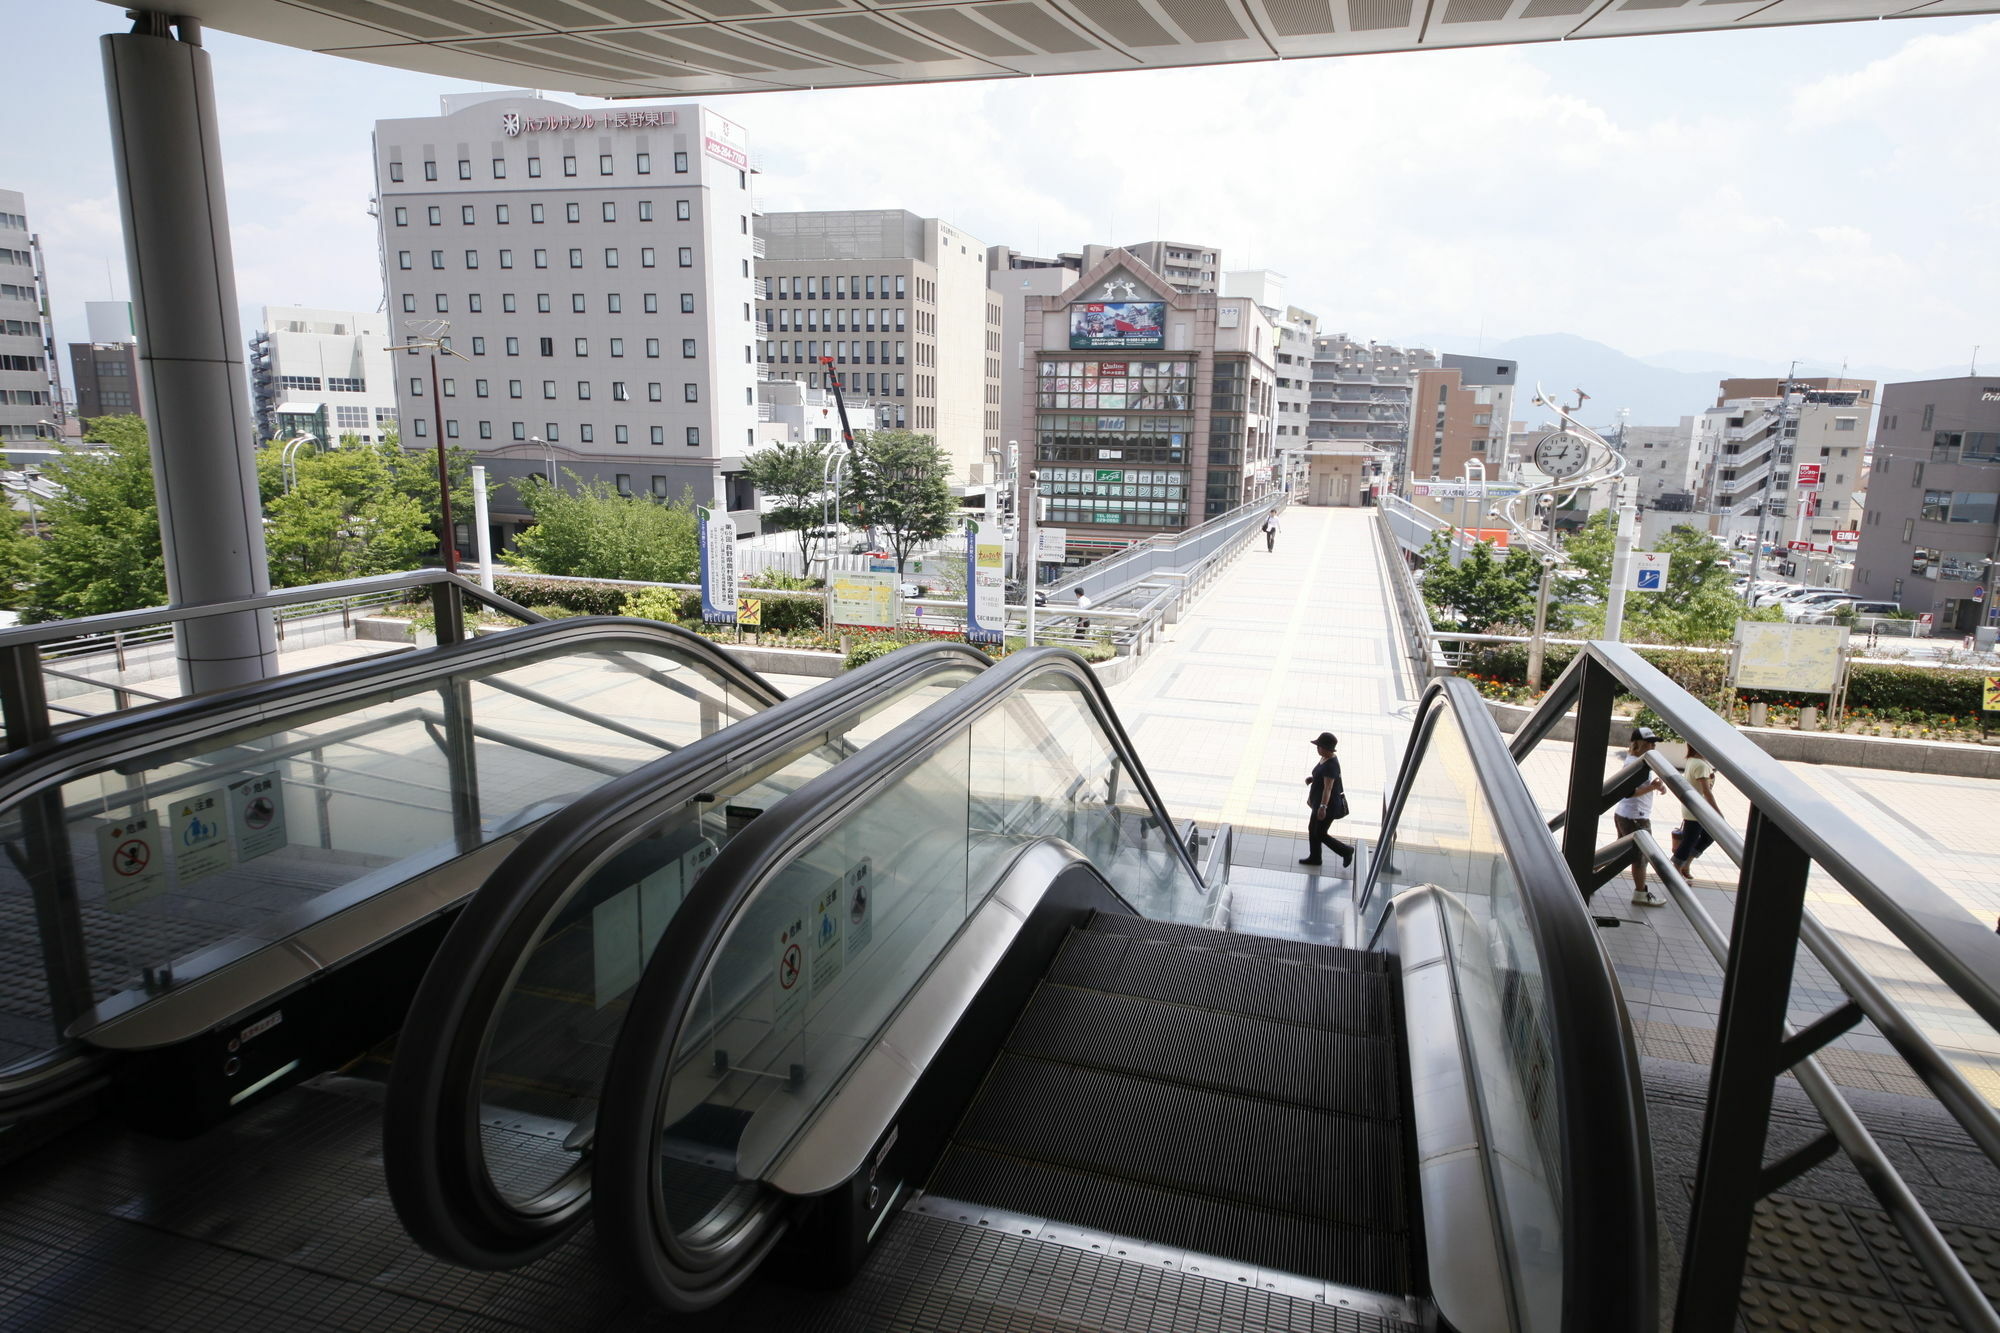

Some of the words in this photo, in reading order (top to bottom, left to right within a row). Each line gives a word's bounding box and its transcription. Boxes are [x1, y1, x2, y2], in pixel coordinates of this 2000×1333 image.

[523, 111, 676, 133] ホテルサンルート長野東口
[1221, 308, 1238, 316] ステラ
[1042, 472, 1093, 481] 信大予約
[1128, 474, 1179, 484] 受付開始
[253, 779, 272, 794] 危険
[194, 798, 214, 812] 注意
[125, 820, 147, 834] 危険
